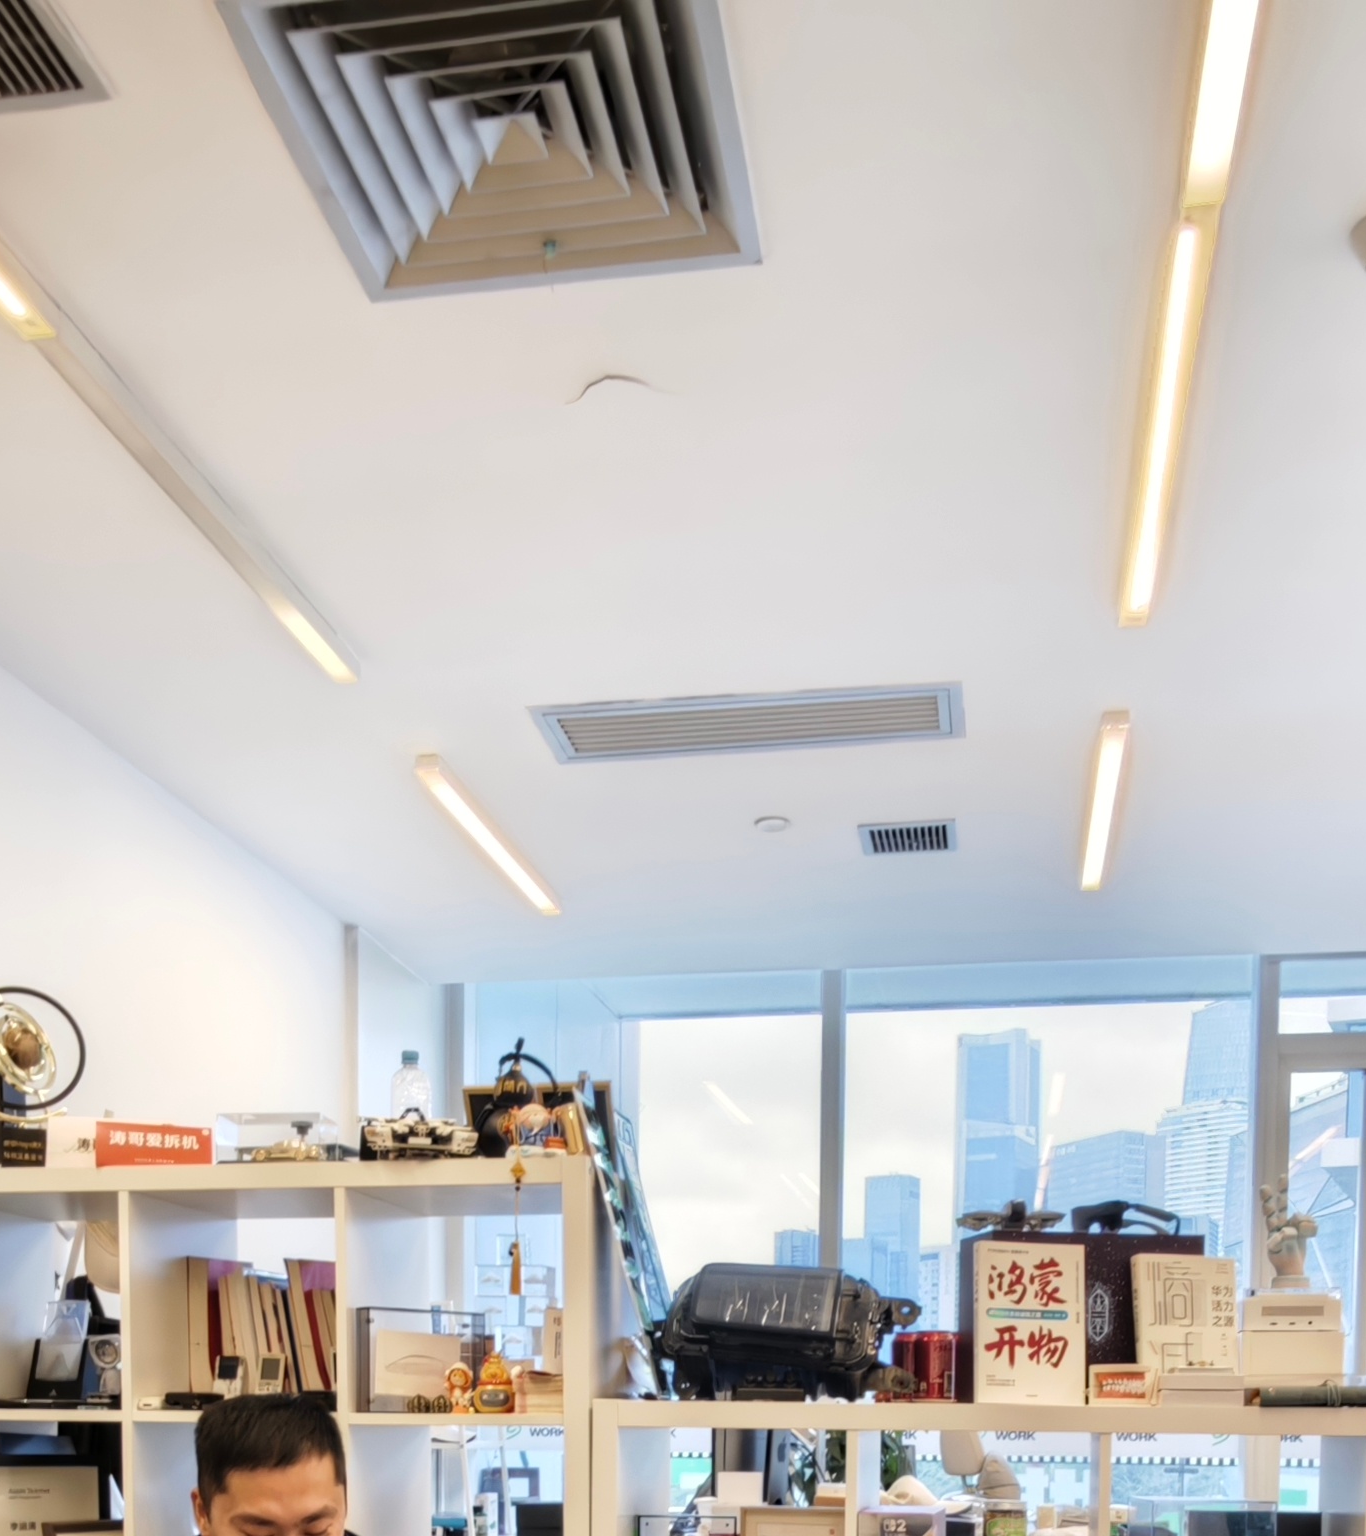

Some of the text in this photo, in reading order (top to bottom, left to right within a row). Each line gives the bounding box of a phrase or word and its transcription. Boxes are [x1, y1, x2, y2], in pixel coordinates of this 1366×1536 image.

[109, 1130, 200, 1150] 涛哥爱拆机
[988, 1256, 1068, 1307] 鸿蒙
[1212, 1286, 1233, 1297] 华为
[1212, 1301, 1234, 1312] 活力
[1212, 1316, 1235, 1327] 之源
[984, 1325, 1069, 1369] 开物
[995, 1430, 1036, 1441] WORK
[1116, 1432, 1158, 1442] WORK
